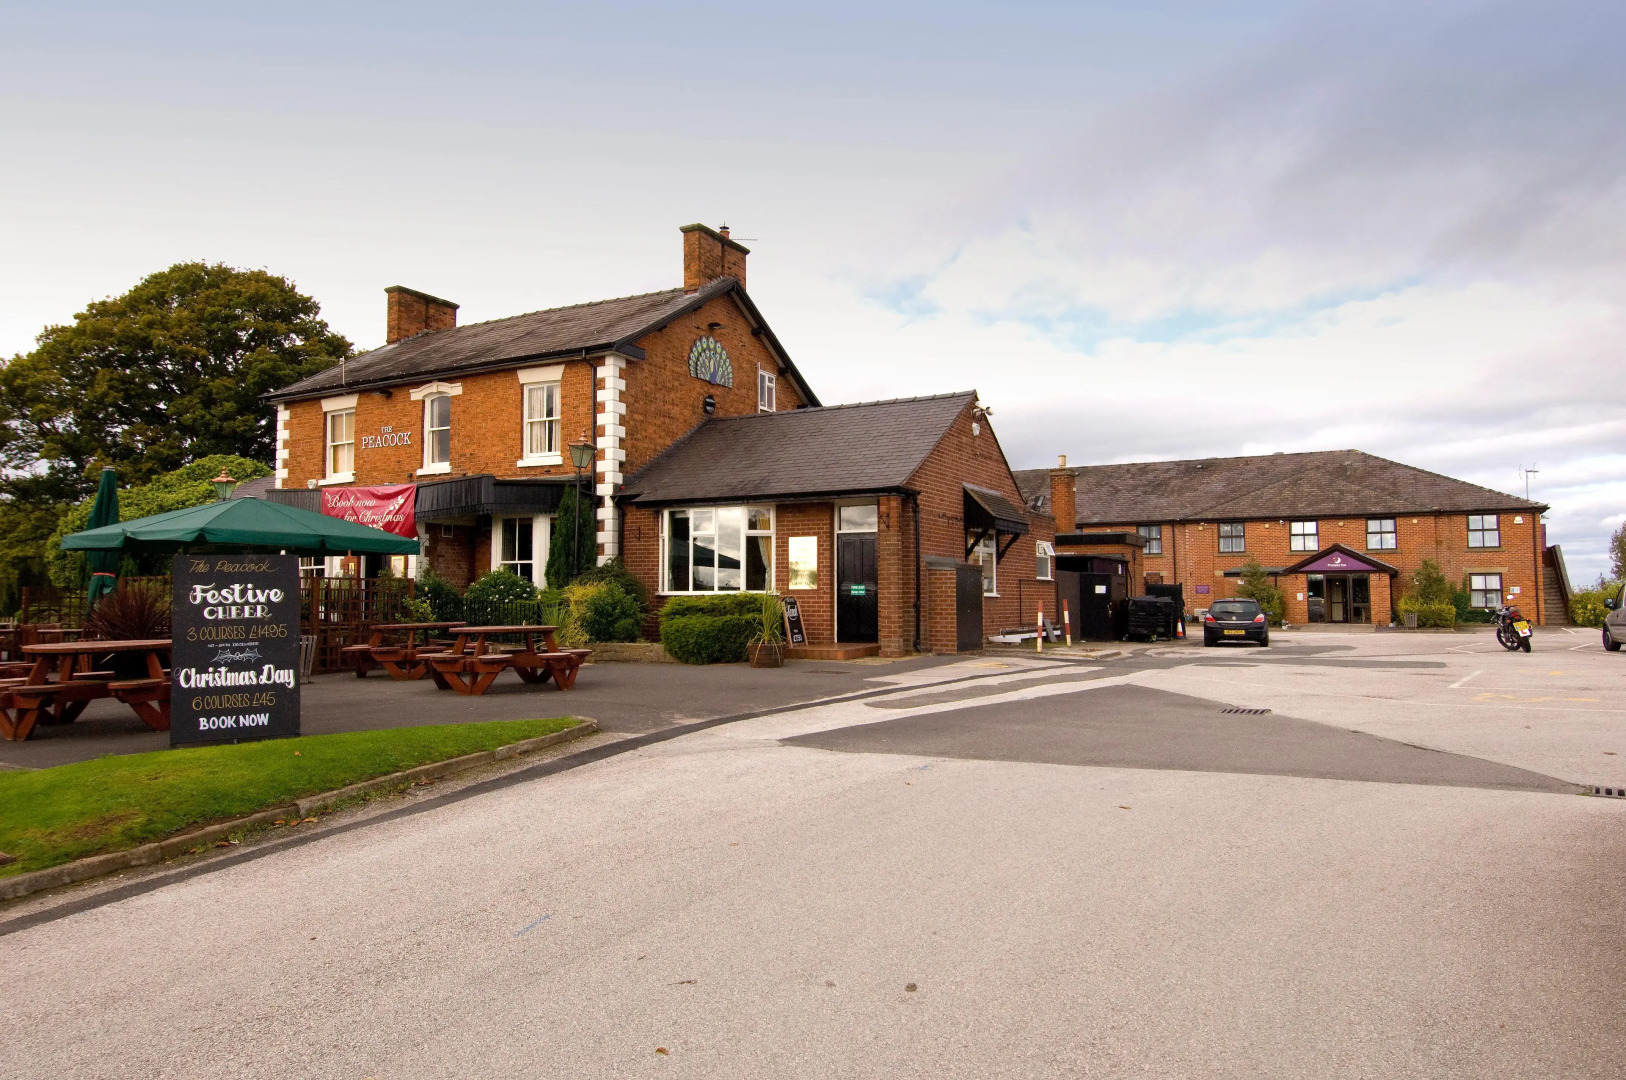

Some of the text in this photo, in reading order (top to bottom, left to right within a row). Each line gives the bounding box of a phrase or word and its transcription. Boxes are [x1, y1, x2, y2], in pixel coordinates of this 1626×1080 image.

[362, 432, 411, 449] PEACOCK
[328, 494, 376, 508] Book now
[344, 509, 404, 523] for Christmas
[189, 559, 280, 573] The Peacock
[189, 582, 285, 605] Festive
[203, 604, 272, 620] CHEER
[187, 627, 198, 641] 3
[200, 625, 245, 641] COURSES
[174, 664, 295, 689] Christmas Day
[192, 691, 276, 711] 6 COURSES £45
[198, 712, 270, 731] BOOK NOW
